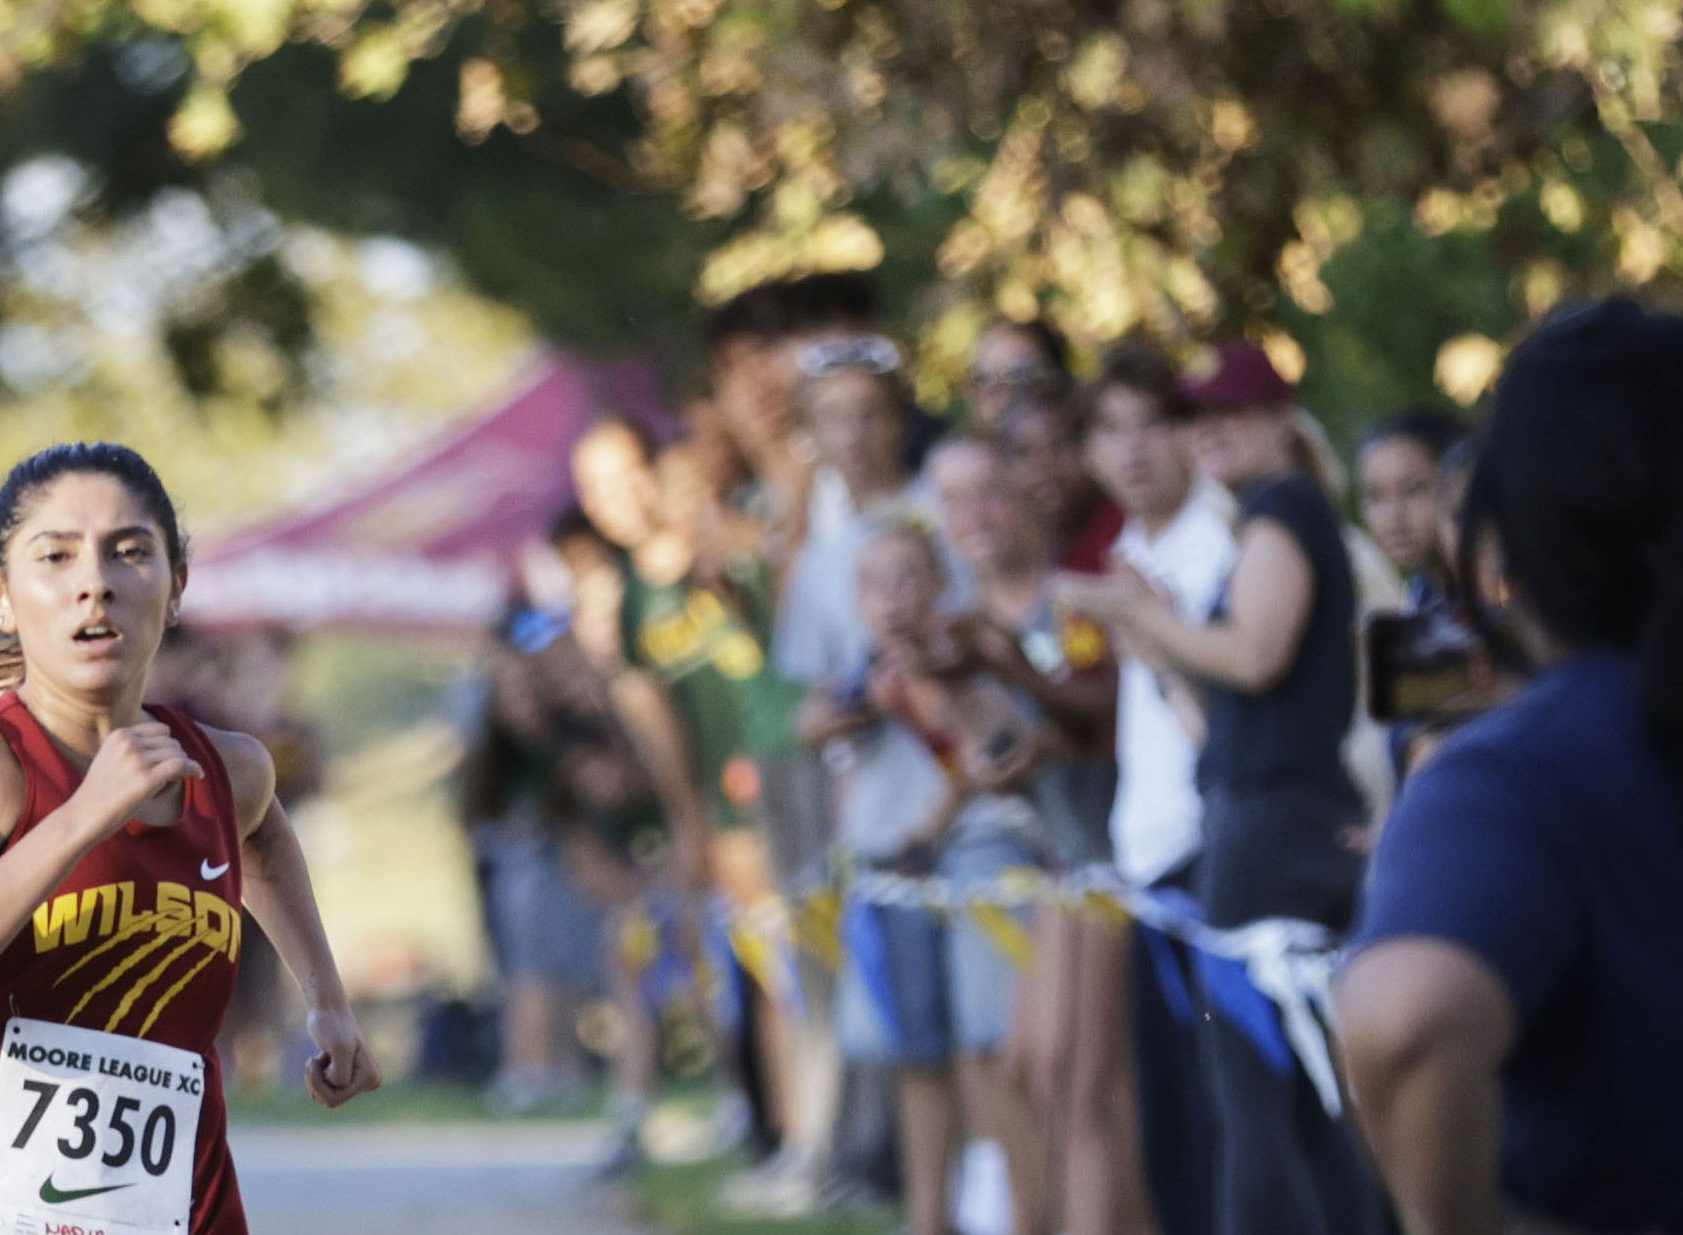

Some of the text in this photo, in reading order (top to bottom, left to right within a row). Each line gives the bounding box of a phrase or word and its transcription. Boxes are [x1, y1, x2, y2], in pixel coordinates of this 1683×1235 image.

[7, 1041, 200, 1096] MOORE LEAGUE XC
[11, 1078, 176, 1176] 7350
